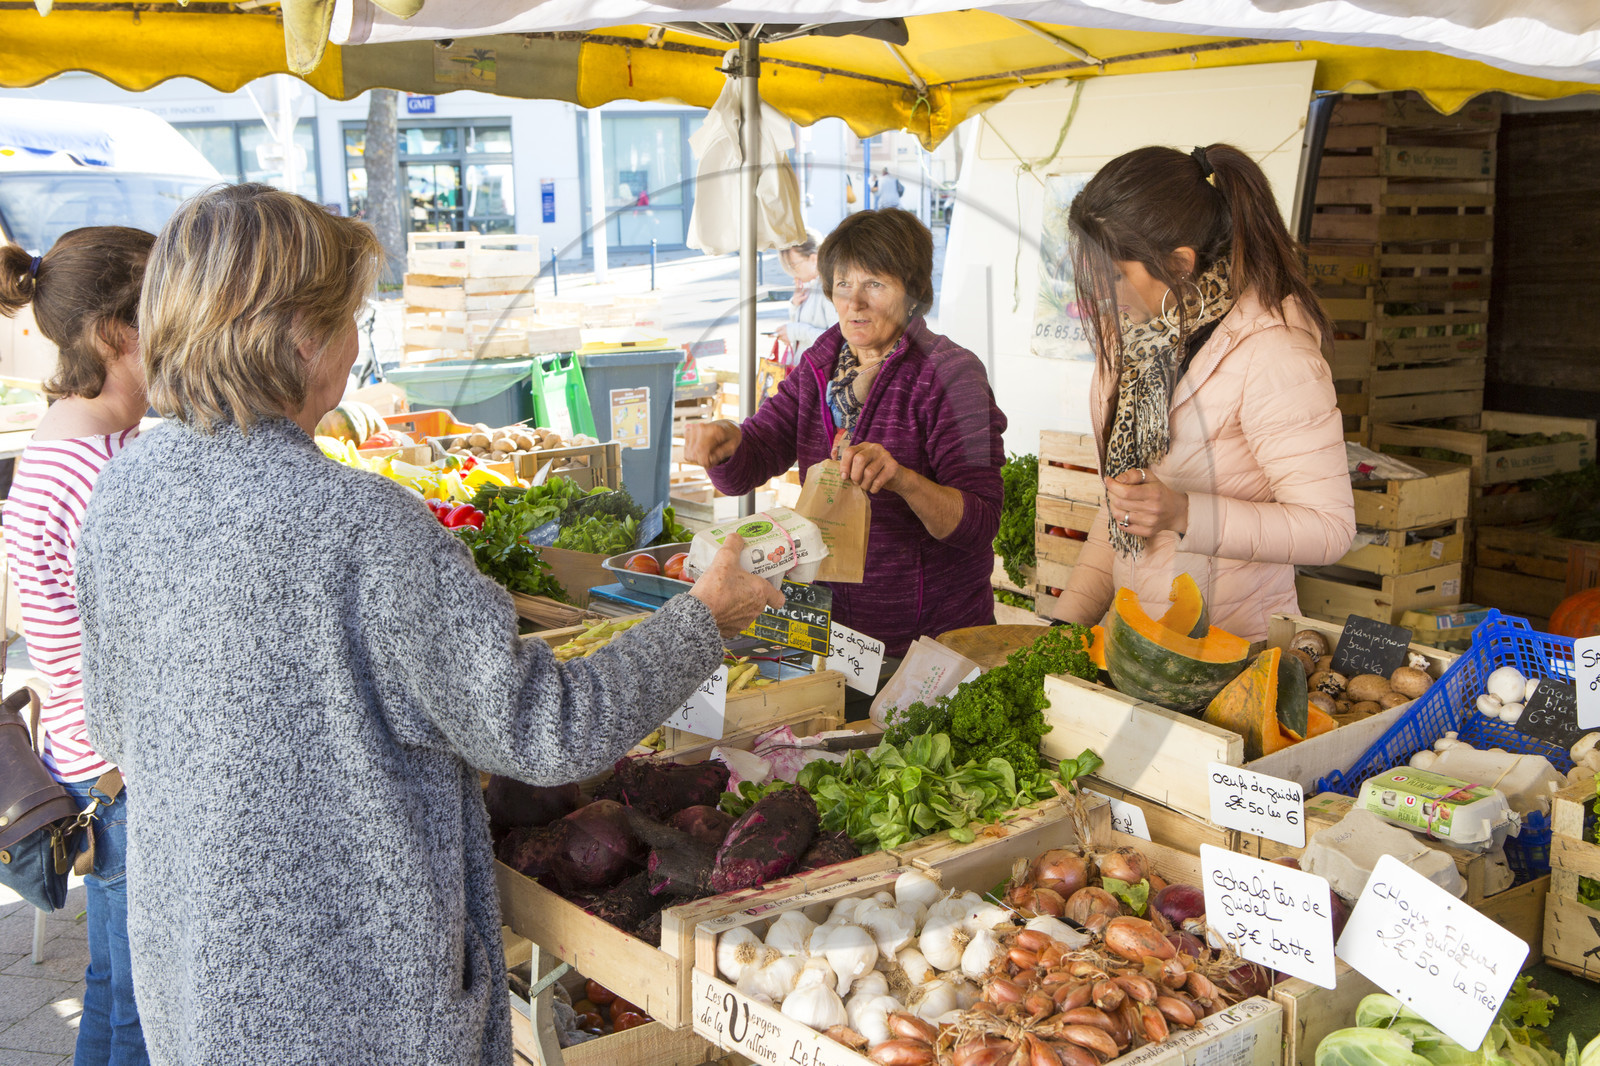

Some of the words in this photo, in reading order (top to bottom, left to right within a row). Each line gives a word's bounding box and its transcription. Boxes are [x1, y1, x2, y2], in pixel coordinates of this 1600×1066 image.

[408, 99, 433, 110] GMF
[789, 621, 809, 637] Calibre
[1286, 810, 1299, 826] 6
[1301, 893, 1328, 919] de
[1268, 927, 1315, 964] botte
[704, 983, 722, 1006] Les
[700, 1006, 713, 1025] de
[713, 1011, 724, 1034] la
